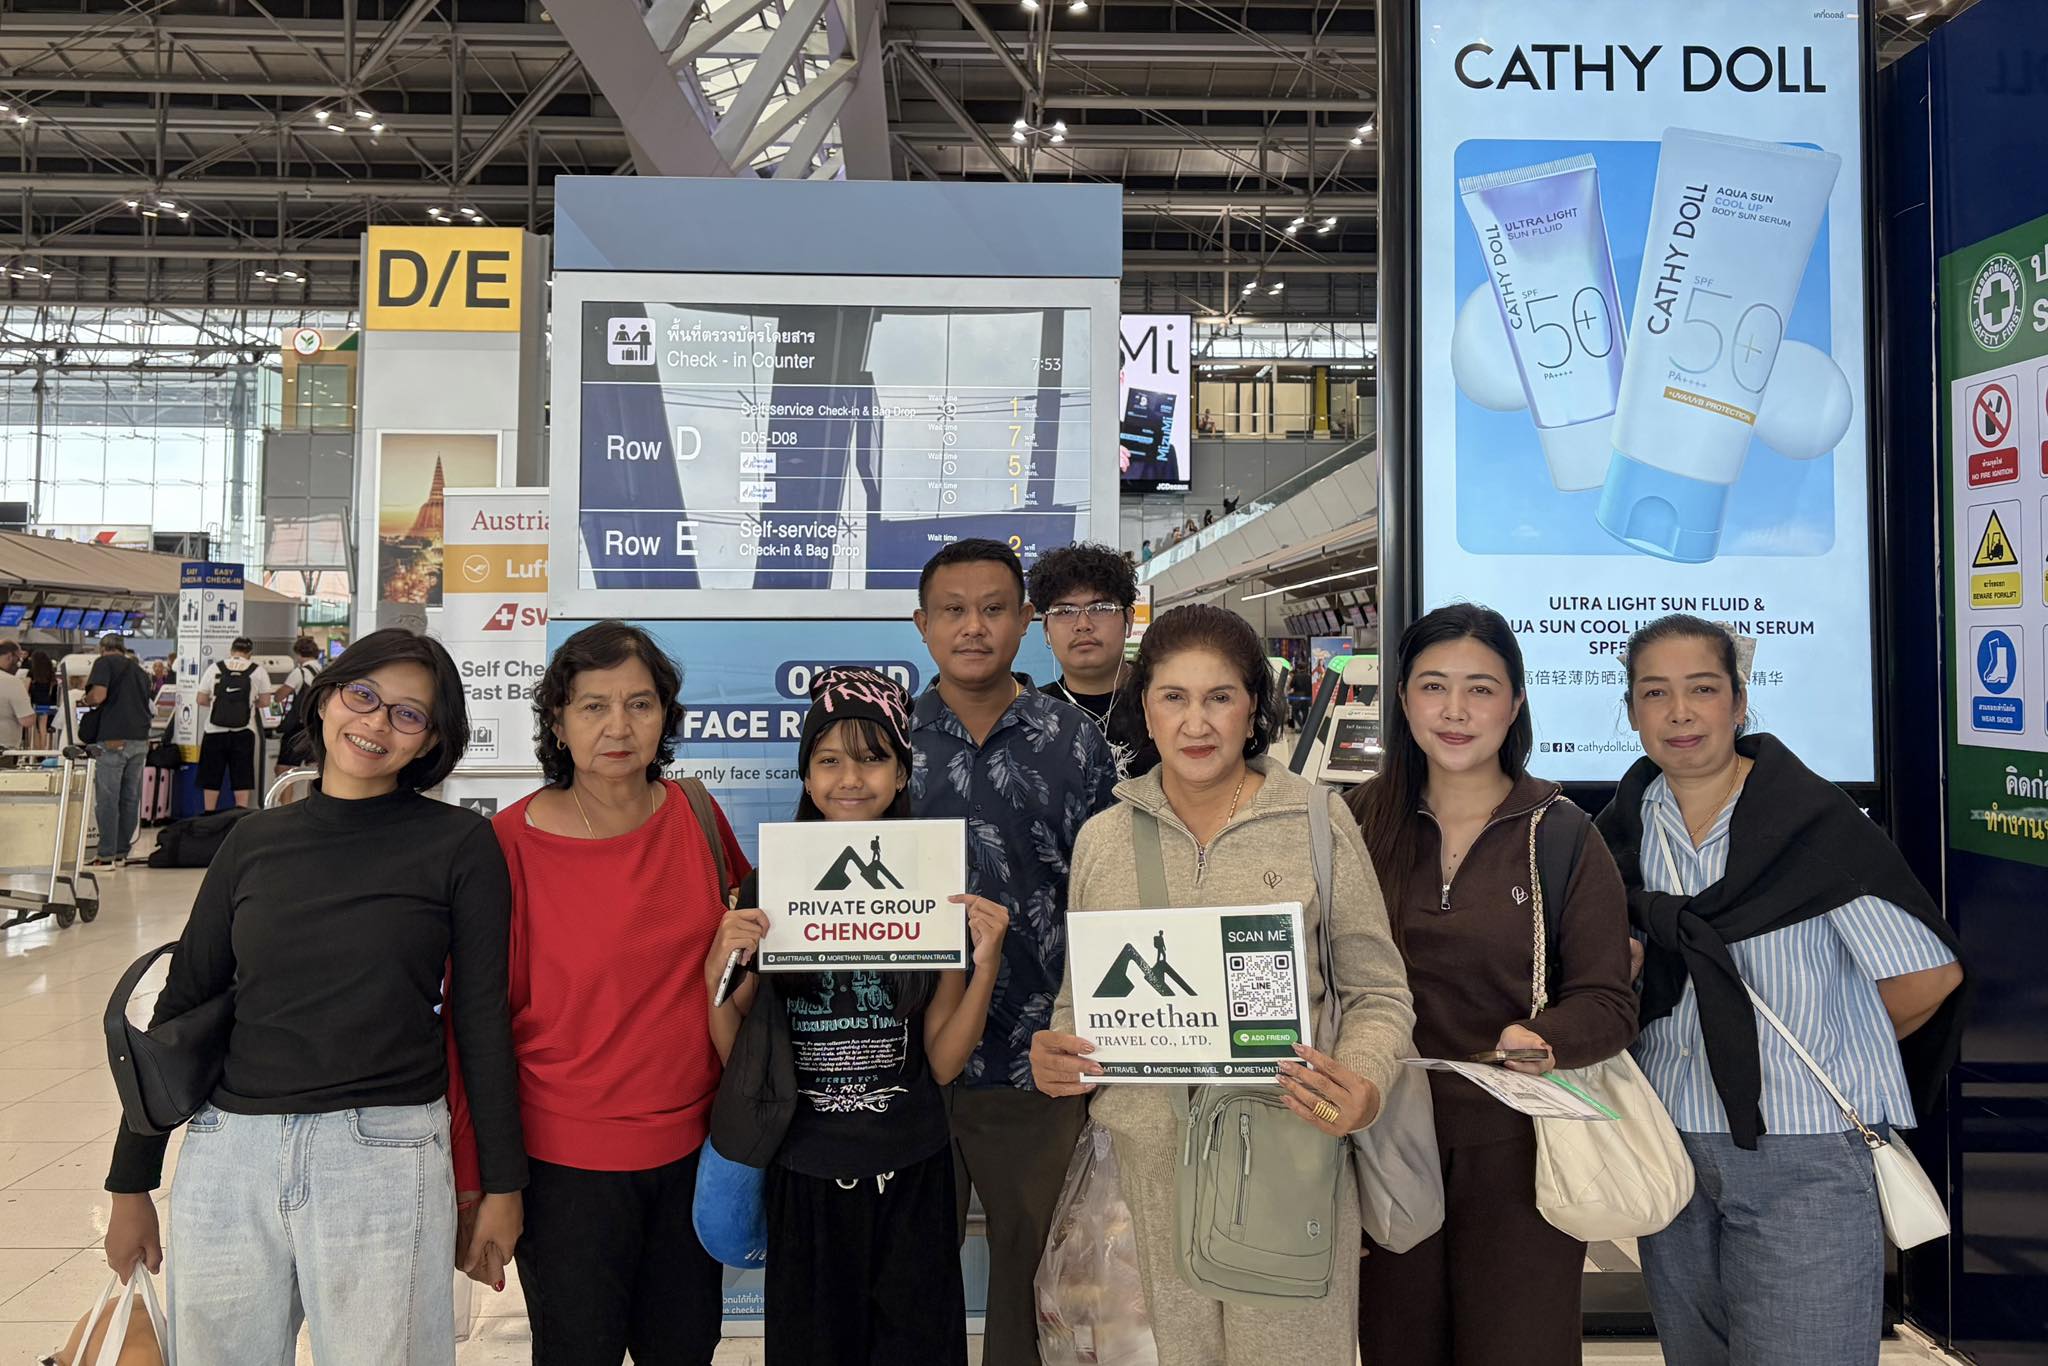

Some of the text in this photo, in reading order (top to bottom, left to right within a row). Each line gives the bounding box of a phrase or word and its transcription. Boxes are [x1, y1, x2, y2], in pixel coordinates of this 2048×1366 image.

[1454, 42, 1827, 93] CATHY DOLL
[1717, 187, 1774, 204] AQUA SUN
[1714, 197, 1764, 213] COOL UP
[1504, 207, 1578, 232] ULTRA LIGHT
[1712, 206, 1792, 228] BODY SUN SERUM
[1507, 222, 1563, 241] SUN FLUID
[1647, 184, 1709, 335] CATHY DOLL
[376, 249, 511, 310] D/E
[1485, 223, 1523, 330] CATHY DOLL
[1693, 275, 1714, 288] SPF
[1521, 289, 1539, 299] SPF
[667, 318, 816, 345] พื้นที่ตรวจบัตรโดยสาร
[1973, 305, 2021, 345] SAFETY FIRST
[667, 350, 718, 369] Check
[733, 351, 747, 369] in
[752, 351, 816, 370] Counter
[740, 402, 917, 419] Self-service Check-in & Bag Drop
[1010, 396, 1018, 417] 1
[607, 425, 702, 462] Row D
[741, 431, 798, 446] D05-D08
[1008, 425, 1021, 447] 7
[1008, 454, 1021, 476] 5
[1010, 483, 1018, 505] 1
[740, 521, 837, 538] Self-service
[928, 533, 958, 542] Wait time
[604, 520, 699, 557] Row E
[1008, 535, 1021, 558] 2
[740, 543, 860, 560] Check-in & Bag Drop
[1973, 590, 2017, 600] BEWARE FORKLIFT
[1549, 596, 1765, 612] ULTRA LIGHT SUN FLUID &
[1510, 620, 1535, 634] UA
[1540, 620, 1576, 634] SUN
[1580, 620, 1630, 634] COOL
[1756, 620, 1815, 635] SERUM
[461, 660, 545, 678] Self Che
[683, 710, 769, 739] FACE
[1577, 741, 1642, 753] cathydollclub
[694, 766, 726, 783] only
[731, 766, 760, 780] face
[765, 768, 799, 780] scan
[788, 899, 936, 916] PRIVATE GROUP
[803, 922, 921, 942] CHENGDU
[1228, 929, 1287, 943] SCAN ME
[826, 954, 885, 962] MORETHAN TRAVEL
[1251, 982, 1272, 990] LINE
[1095, 1035, 1212, 1048] TRAVEL CO., LTD.
[1103, 1066, 1139, 1074] MTTRAVEL
[1153, 1066, 1219, 1074] MORETHAN TRAVEL
[1234, 1066, 1284, 1074] MORETHAN.TR
